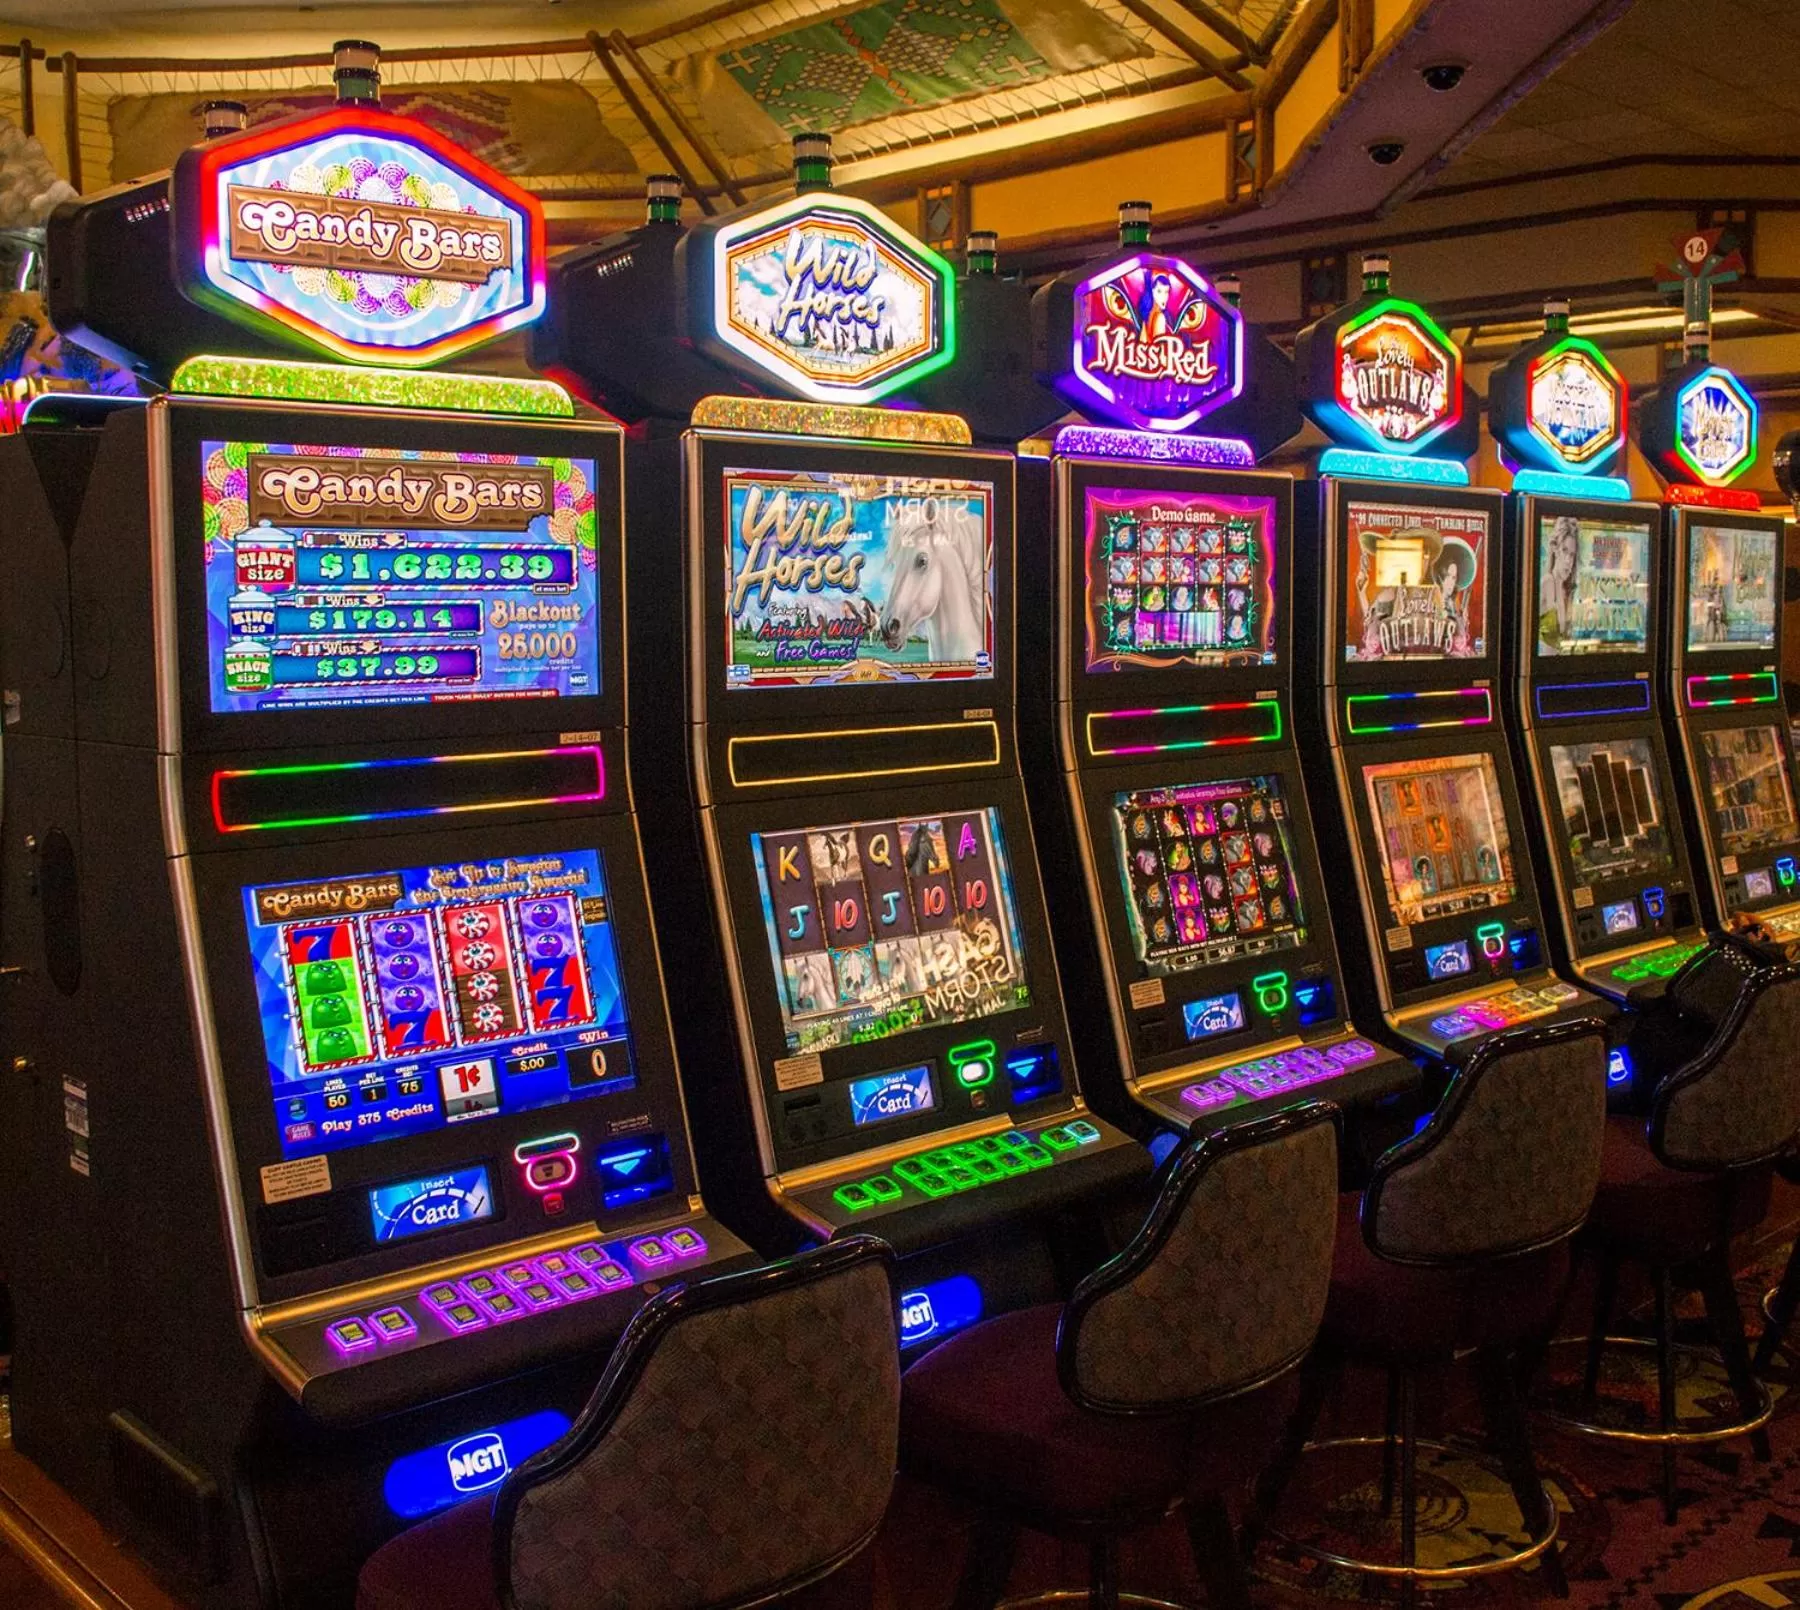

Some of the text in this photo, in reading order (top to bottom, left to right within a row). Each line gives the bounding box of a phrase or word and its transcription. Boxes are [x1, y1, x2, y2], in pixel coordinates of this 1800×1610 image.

[240, 200, 504, 272] Candy Bars
[1687, 241, 1705, 257] 14
[785, 228, 877, 294] Wild
[776, 275, 887, 339] Horses
[1086, 321, 1218, 385] Miss Red
[1375, 336, 1415, 378] Lovely
[1358, 368, 1433, 412] OUTLAWS
[262, 465, 544, 523] Candy Bars
[743, 483, 854, 550] Wild
[1151, 505, 1217, 524] Demo Game
[338, 533, 378, 547] Wins
[237, 551, 295, 569] GIANT
[247, 565, 284, 581] size
[320, 552, 555, 582] $1,622.39
[731, 537, 866, 617] Horses
[326, 594, 360, 607] Wins
[489, 600, 582, 629] Blackout
[231, 610, 275, 626] KING
[240, 622, 266, 634] size
[309, 608, 453, 631] $179.14
[323, 641, 357, 654] Wins
[775, 639, 804, 660] Free
[809, 636, 860, 660] Games!
[1379, 617, 1458, 656] OUTLAWS
[317, 654, 439, 679] $37.99
[869, 833, 893, 869] Q
[957, 822, 977, 860] A
[779, 845, 801, 882] K
[264, 881, 401, 916] Candy Bars
[881, 891, 901, 925] J
[923, 885, 946, 917] 10
[964, 879, 988, 911] 10
[788, 904, 811, 941] J
[833, 898, 859, 931] 10
[578, 1030, 609, 1043] Win
[1203, 1014, 1229, 1031] Card
[511, 1043, 548, 1056] Credit
[591, 1049, 607, 1077] 0
[453, 1064, 482, 1093] 1¢
[520, 1056, 545, 1073] $.00
[328, 1095, 347, 1108] 50
[371, 1089, 377, 1100] 1
[402, 1081, 419, 1093] 75
[877, 1092, 912, 1113] Card
[321, 1103, 434, 1134] Play 375 Credits
[421, 1176, 454, 1192] Insert
[412, 1199, 460, 1226] Card
[450, 1442, 504, 1481] NGT
